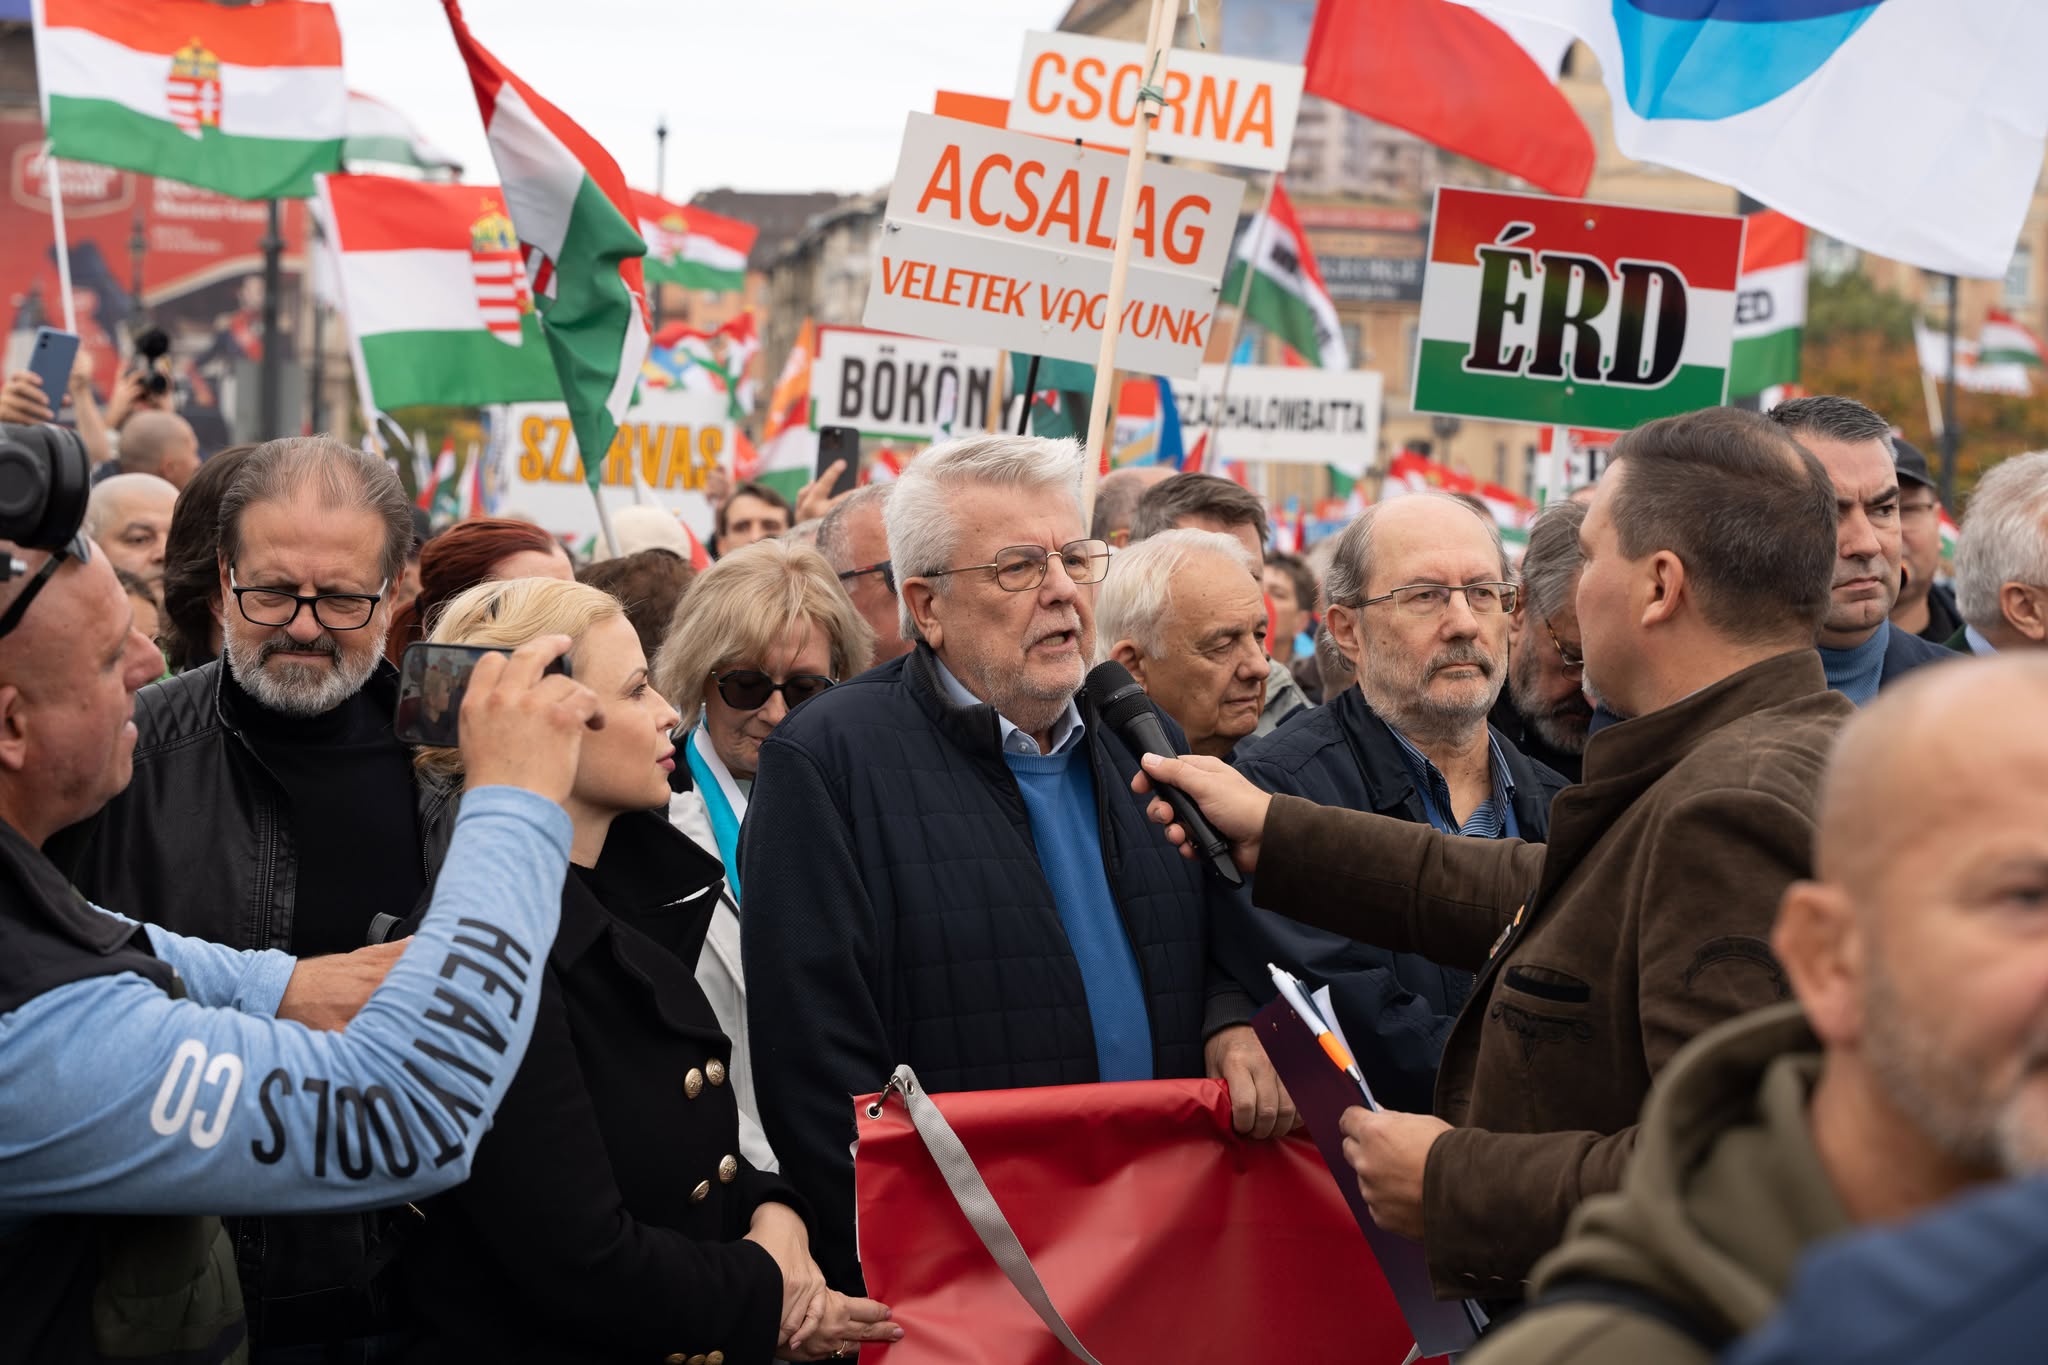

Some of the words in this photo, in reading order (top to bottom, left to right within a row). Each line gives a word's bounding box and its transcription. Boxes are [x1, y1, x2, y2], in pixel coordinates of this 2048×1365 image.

[1027, 51, 1275, 148] CSORNA
[916, 144, 1212, 266] ACSALAG
[881, 257, 1032, 317] VELETEK
[1465, 224, 1690, 388] ÉRD
[519, 416, 724, 491] SZRVAS
[403, 918, 533, 1138] HEAVY
[149, 1038, 244, 1149] CO
[251, 1067, 465, 1180] TOOLS
